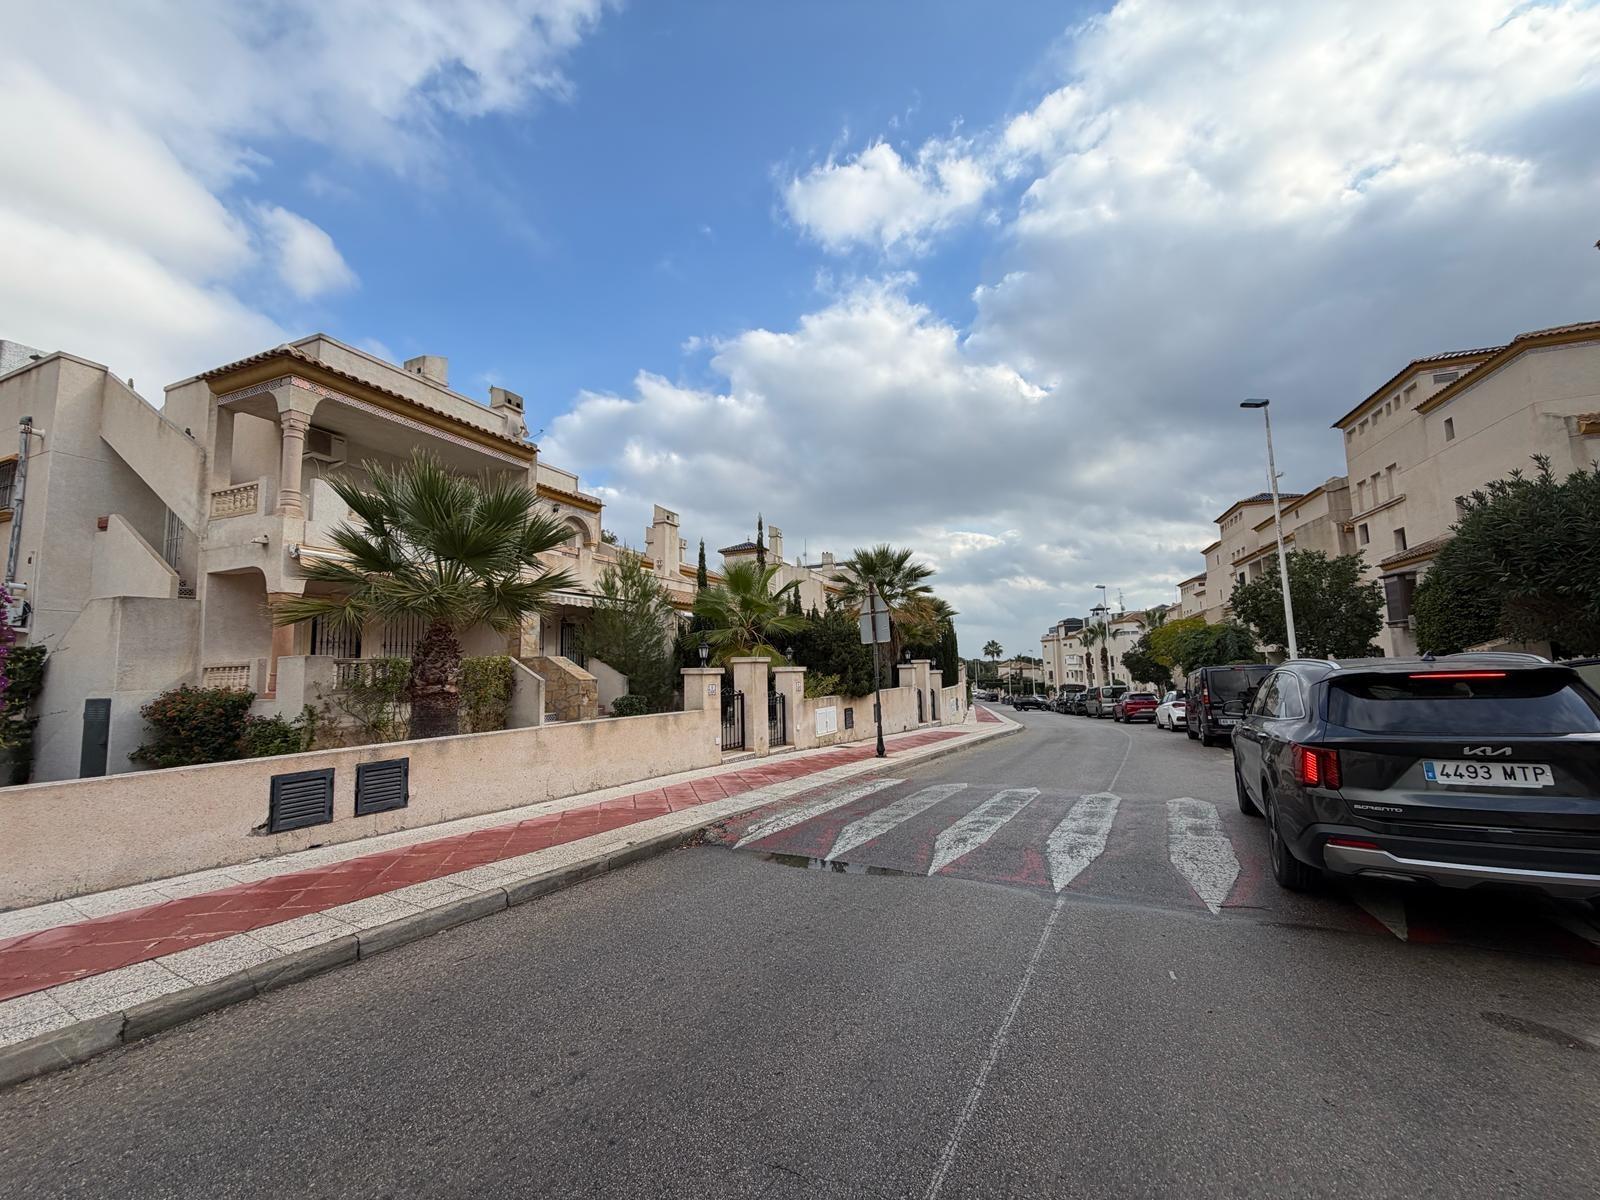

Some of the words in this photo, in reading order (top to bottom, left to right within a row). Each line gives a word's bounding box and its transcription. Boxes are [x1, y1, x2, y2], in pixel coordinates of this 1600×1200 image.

[1440, 764, 1493, 780] 4493
[1502, 765, 1546, 782] MTP
[1353, 804, 1403, 813] SORENTO
